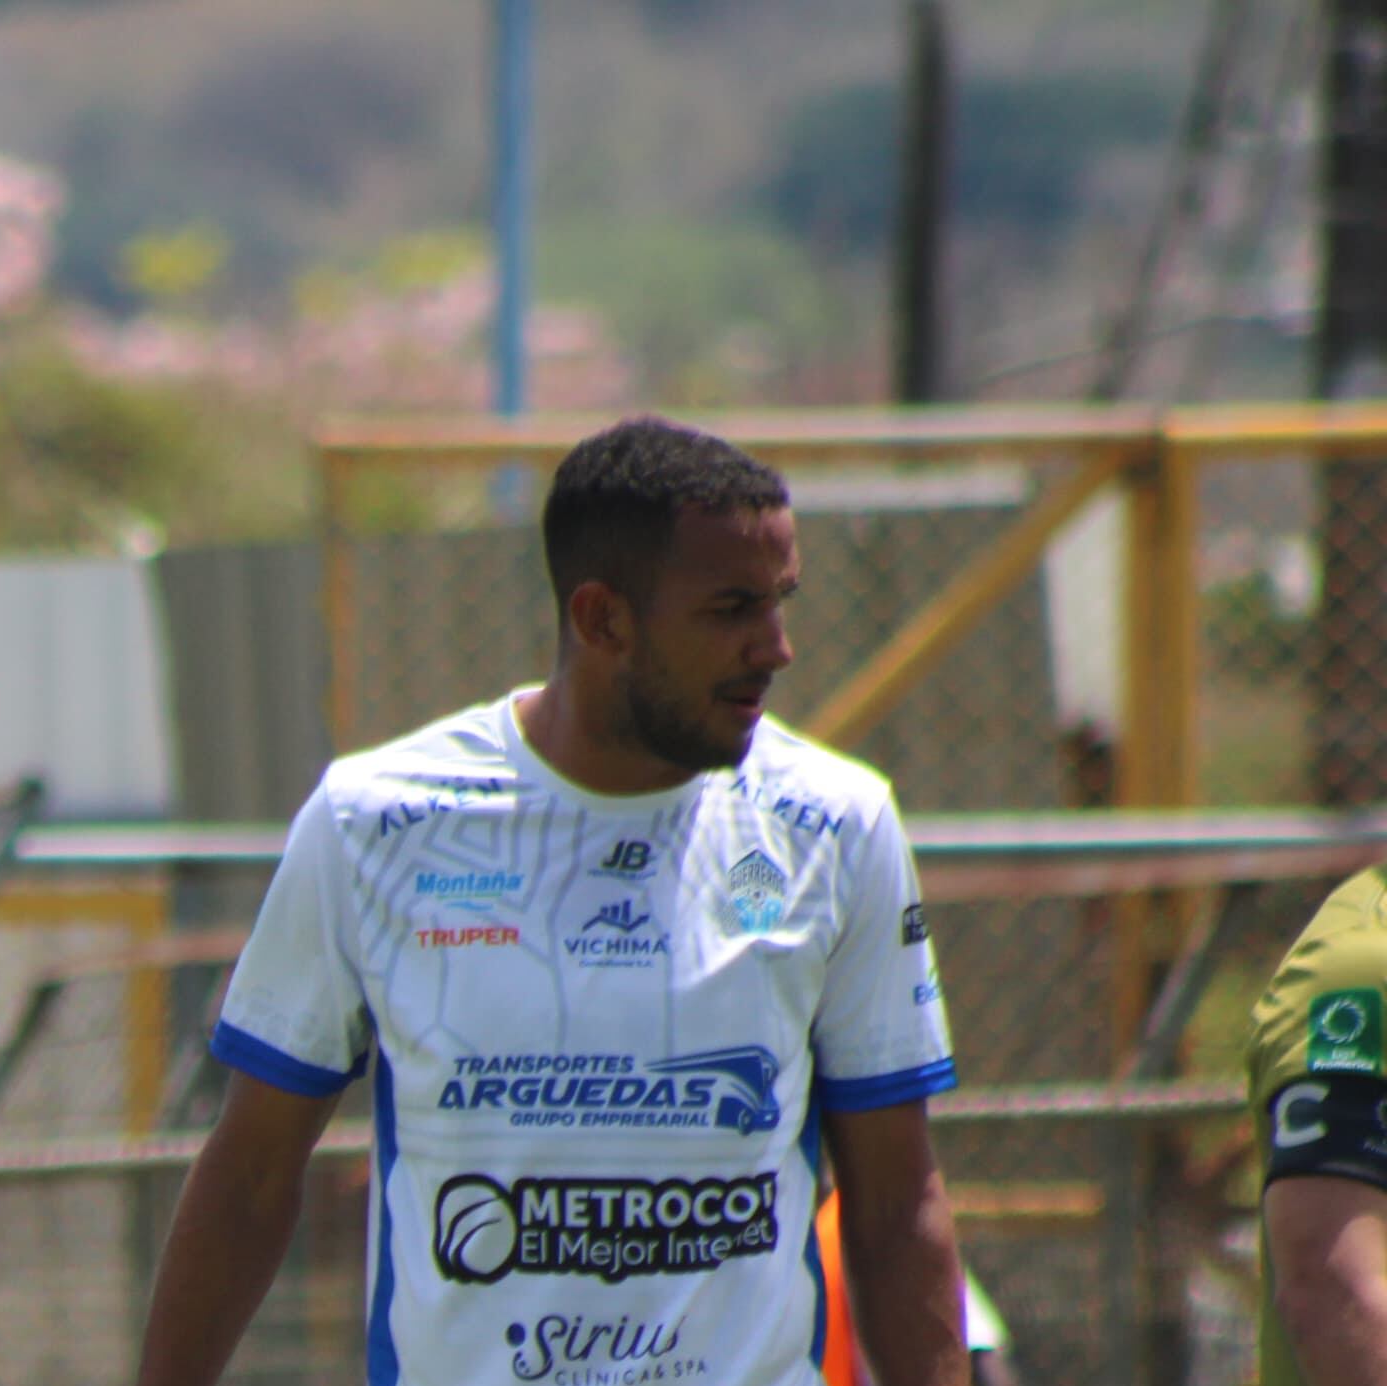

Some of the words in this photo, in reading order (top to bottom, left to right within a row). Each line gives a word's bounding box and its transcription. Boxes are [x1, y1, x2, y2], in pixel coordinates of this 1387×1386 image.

[602, 840, 651, 870] JB
[415, 870, 523, 894] Montaña
[416, 926, 521, 948] TRUPER
[453, 1055, 635, 1075] TRANSPORTES
[437, 1078, 717, 1110] ARGUEDAS
[510, 1112, 575, 1128] GRUPO
[579, 1112, 709, 1128] EMPRESARIAL
[1275, 1082, 1330, 1148] C
[521, 1231, 546, 1264] El
[559, 1231, 659, 1274] Mejor
[674, 1359, 707, 1378] SPA
